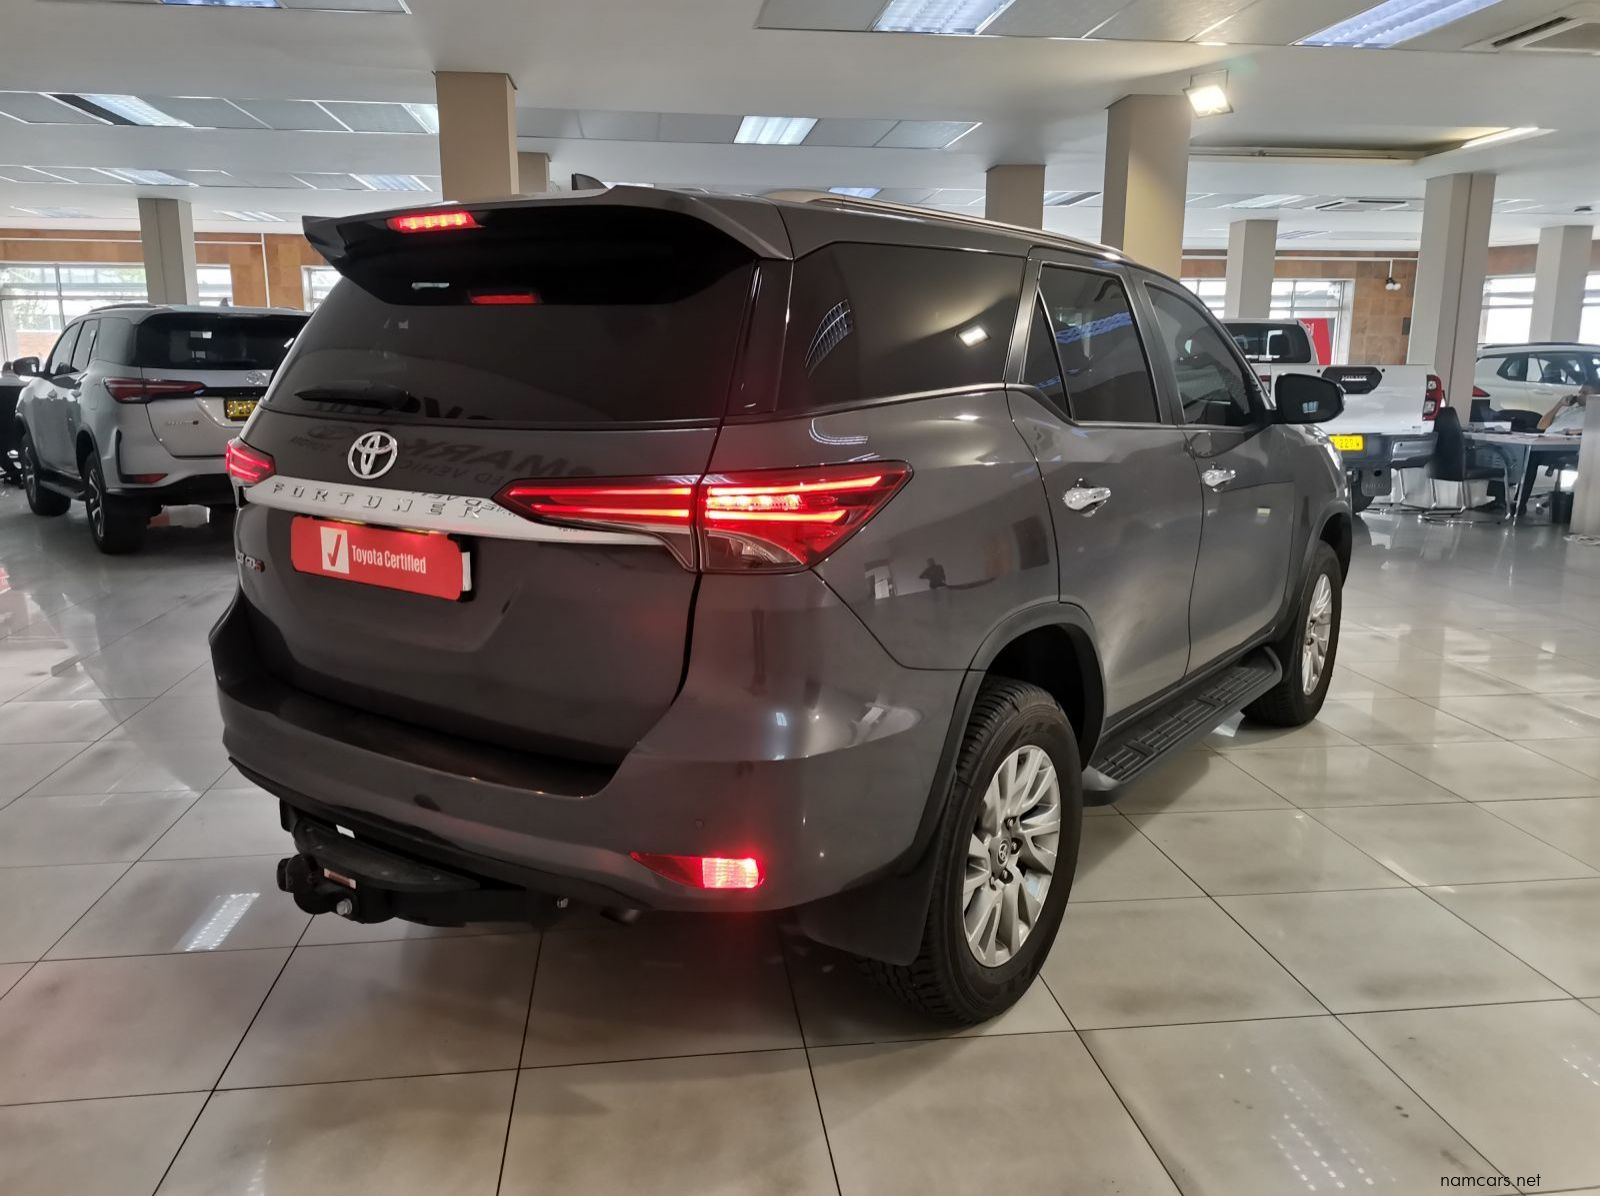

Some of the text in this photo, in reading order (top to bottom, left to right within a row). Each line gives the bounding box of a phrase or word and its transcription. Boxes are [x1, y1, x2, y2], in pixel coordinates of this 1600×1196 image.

[272, 482, 483, 520] FORTUNER
[351, 544, 427, 576] Toyota Certified
